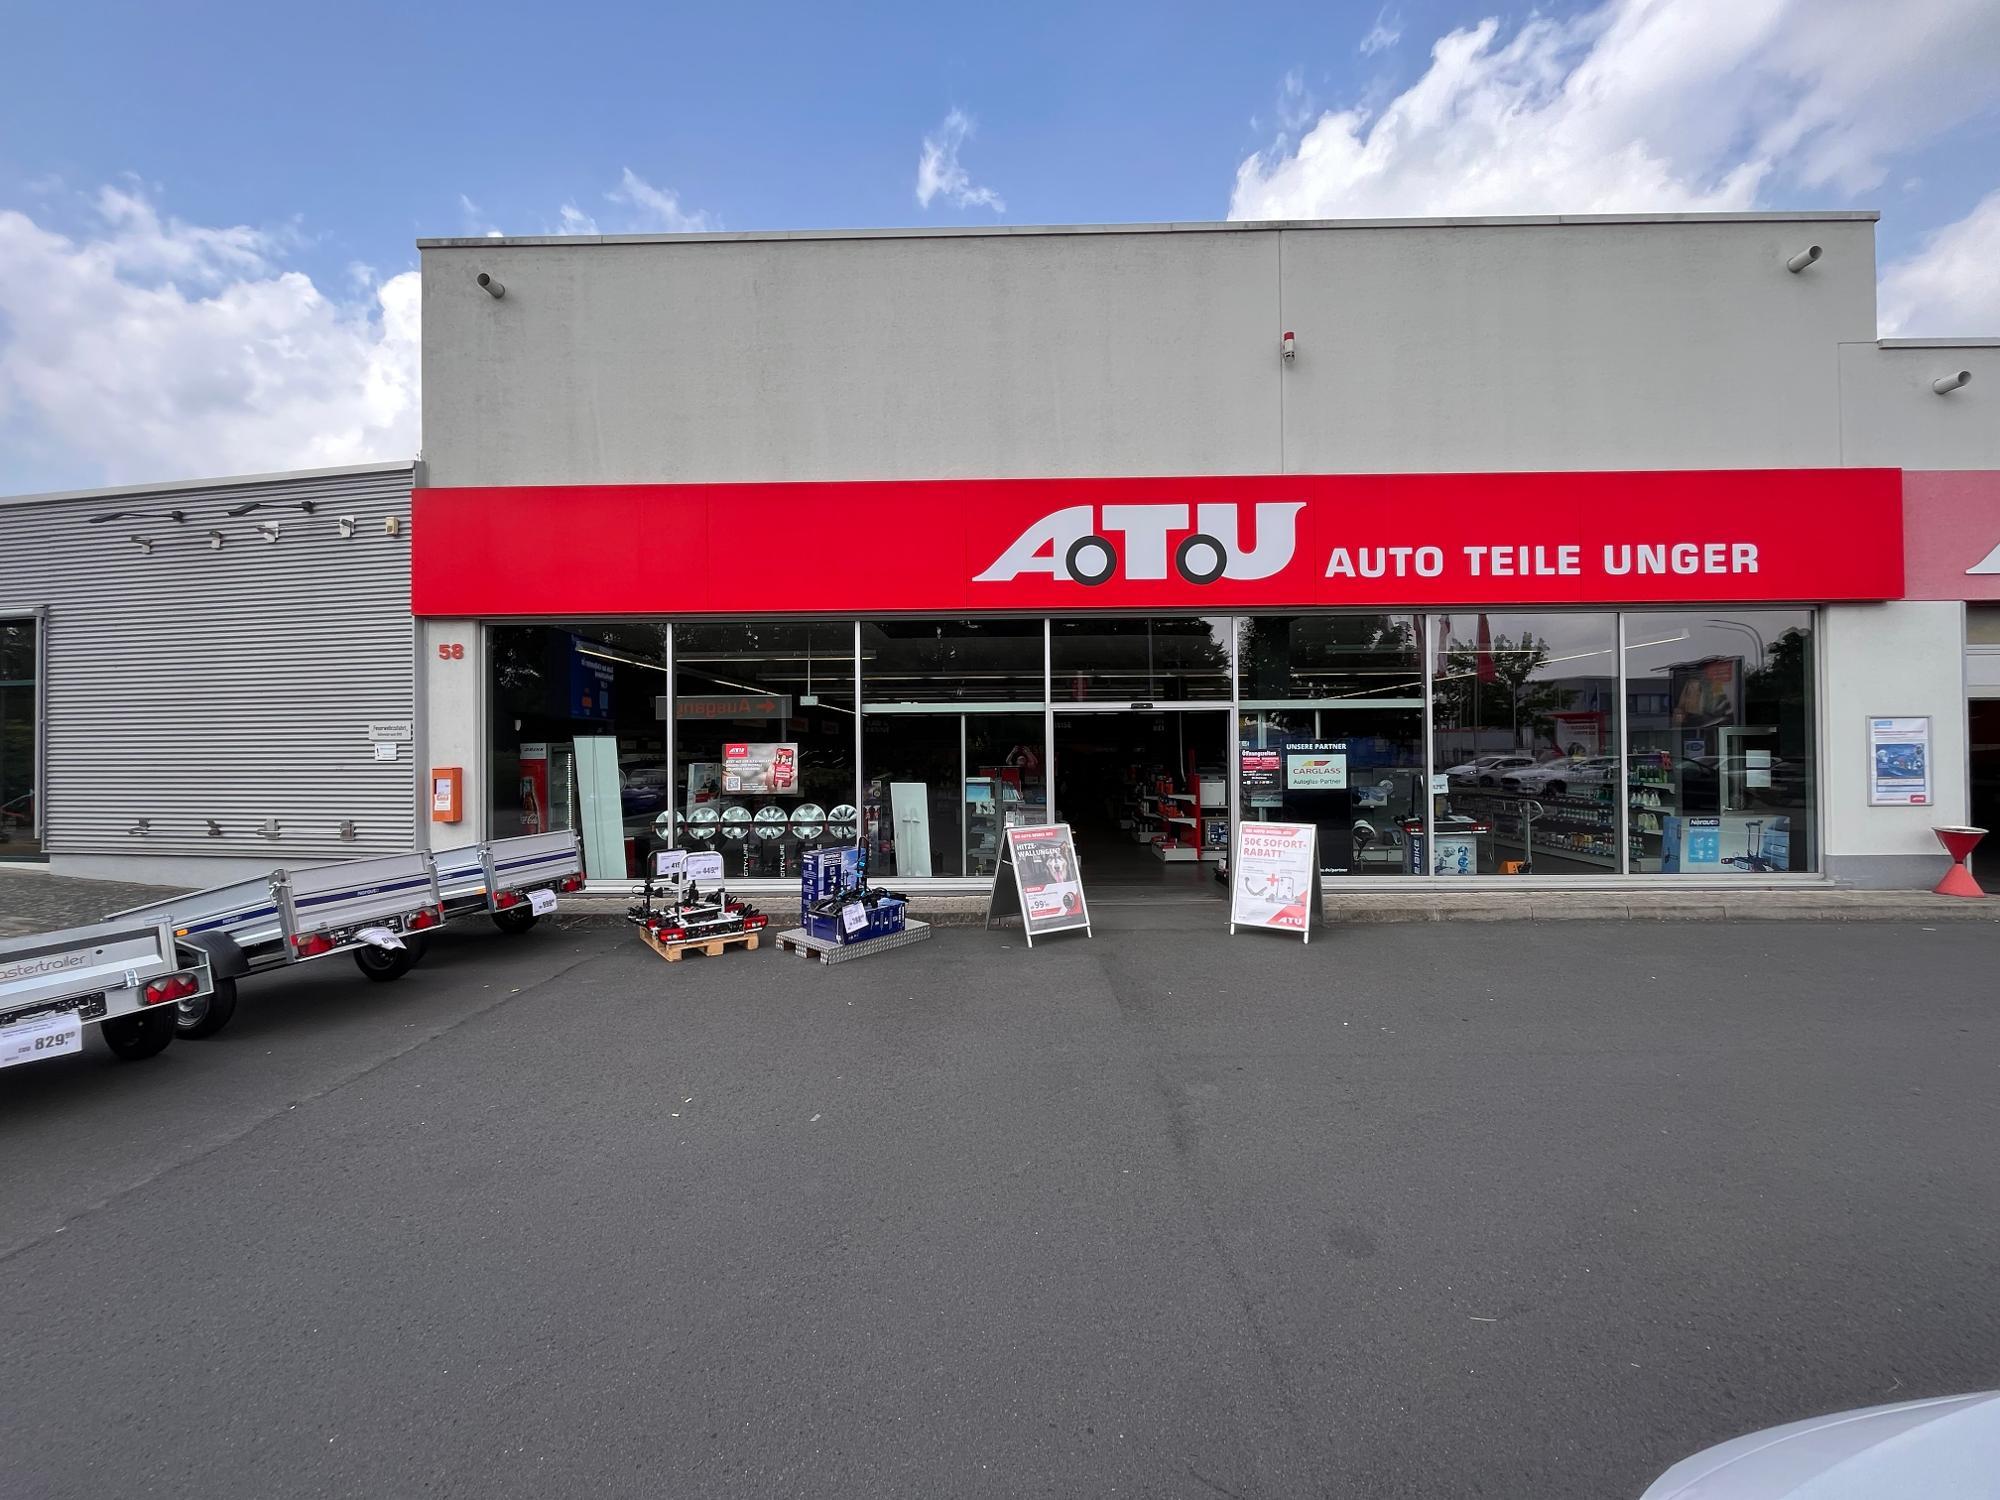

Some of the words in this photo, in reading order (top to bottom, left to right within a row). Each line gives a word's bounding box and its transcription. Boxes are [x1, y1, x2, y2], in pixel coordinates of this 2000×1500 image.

[1325, 547, 1444, 579] AUTO
[1464, 545, 1582, 577] TEILE
[1603, 543, 1760, 576] UNGER
[439, 643, 464, 660] 58
[1244, 837, 1262, 847] 50€
[1279, 916, 1302, 925] ATU
